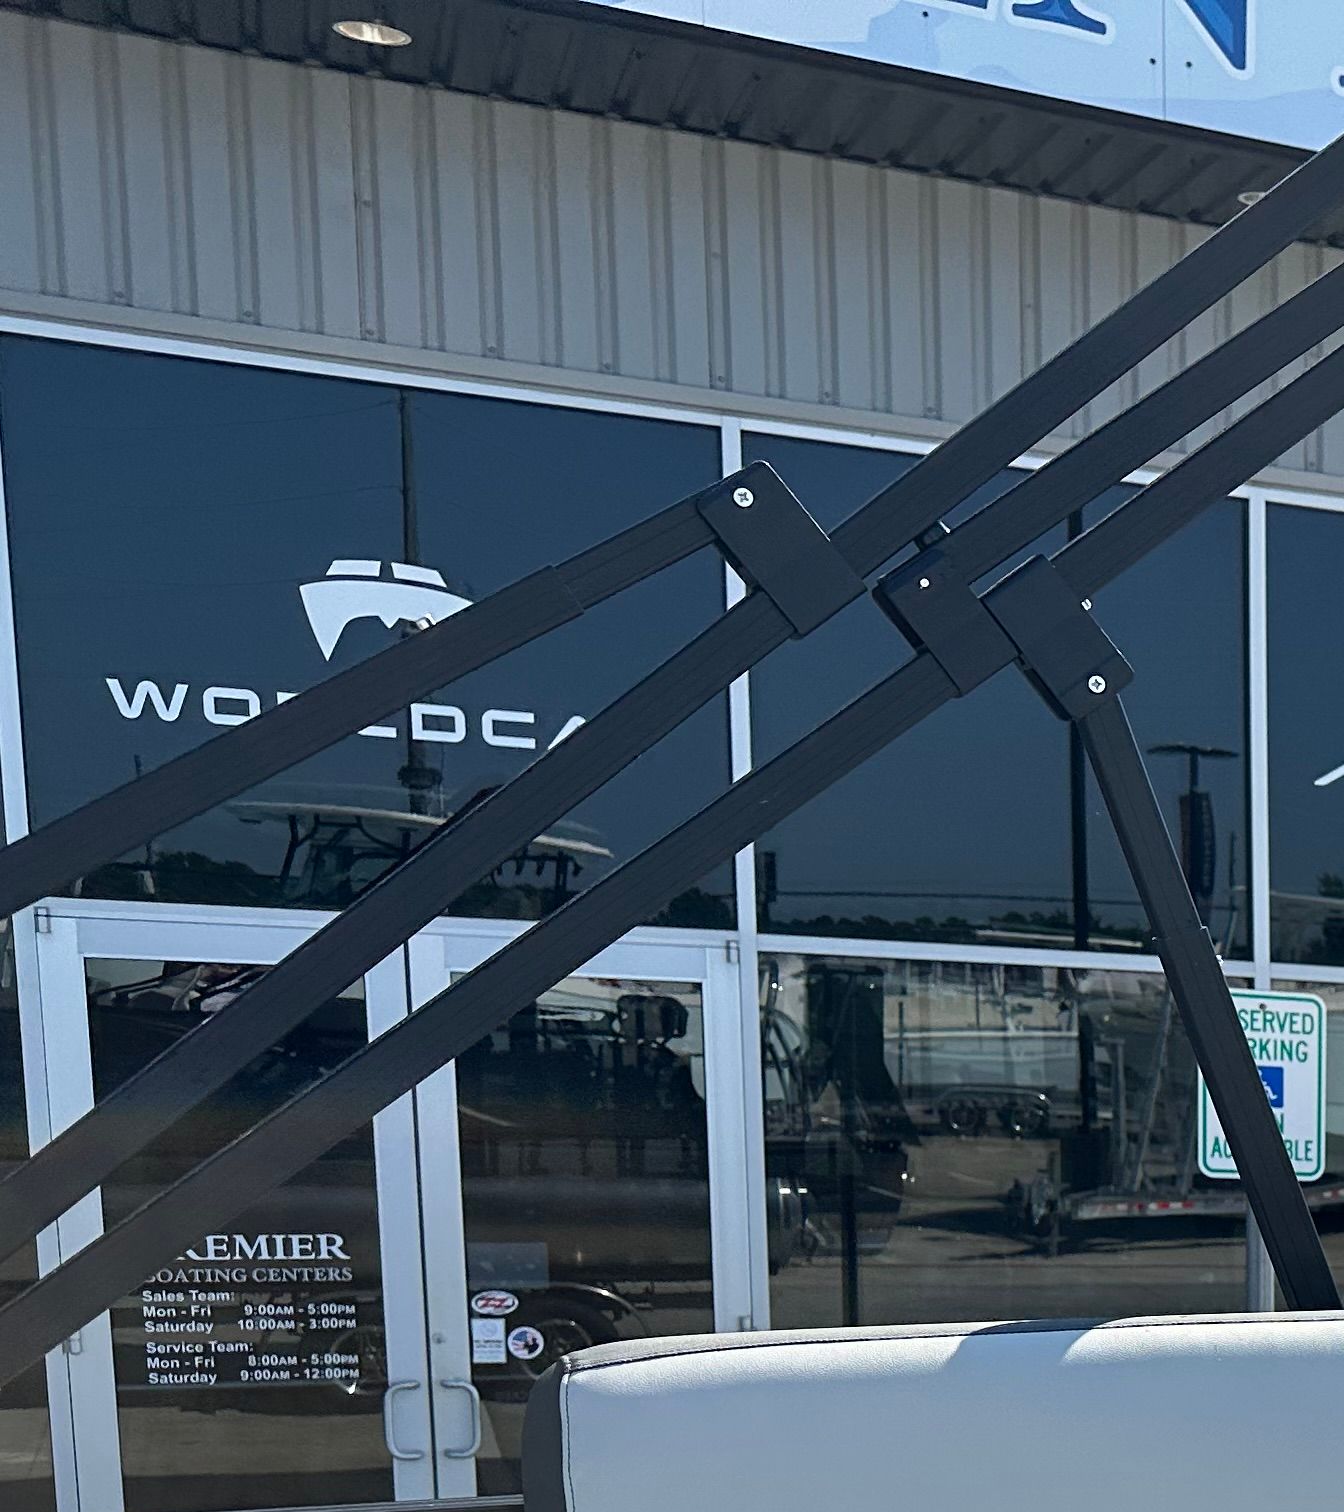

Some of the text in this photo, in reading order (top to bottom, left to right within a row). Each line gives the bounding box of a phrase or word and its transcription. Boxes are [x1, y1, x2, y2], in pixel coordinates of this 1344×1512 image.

[1239, 1008, 1315, 1035] SERVED
[1247, 1038, 1308, 1063] RKING
[176, 1233, 351, 1261] EMIER
[143, 1266, 353, 1283] OATING CENTERS
[142, 1290, 235, 1302] Sales Team:
[143, 1305, 176, 1318] Mon
[191, 1304, 211, 1317] Fri
[244, 1304, 294, 1316] 9:00AM
[307, 1303, 356, 1315] 5:00PM
[144, 1320, 214, 1335] Saturday
[238, 1319, 295, 1331] 10:00AM
[146, 1340, 253, 1354] Service Team:
[147, 1357, 180, 1369] Mon
[194, 1356, 215, 1368] Fri
[311, 1353, 359, 1365] 5:00PM
[148, 1371, 217, 1386] Saturday
[303, 1367, 360, 1379] 12:00PM
